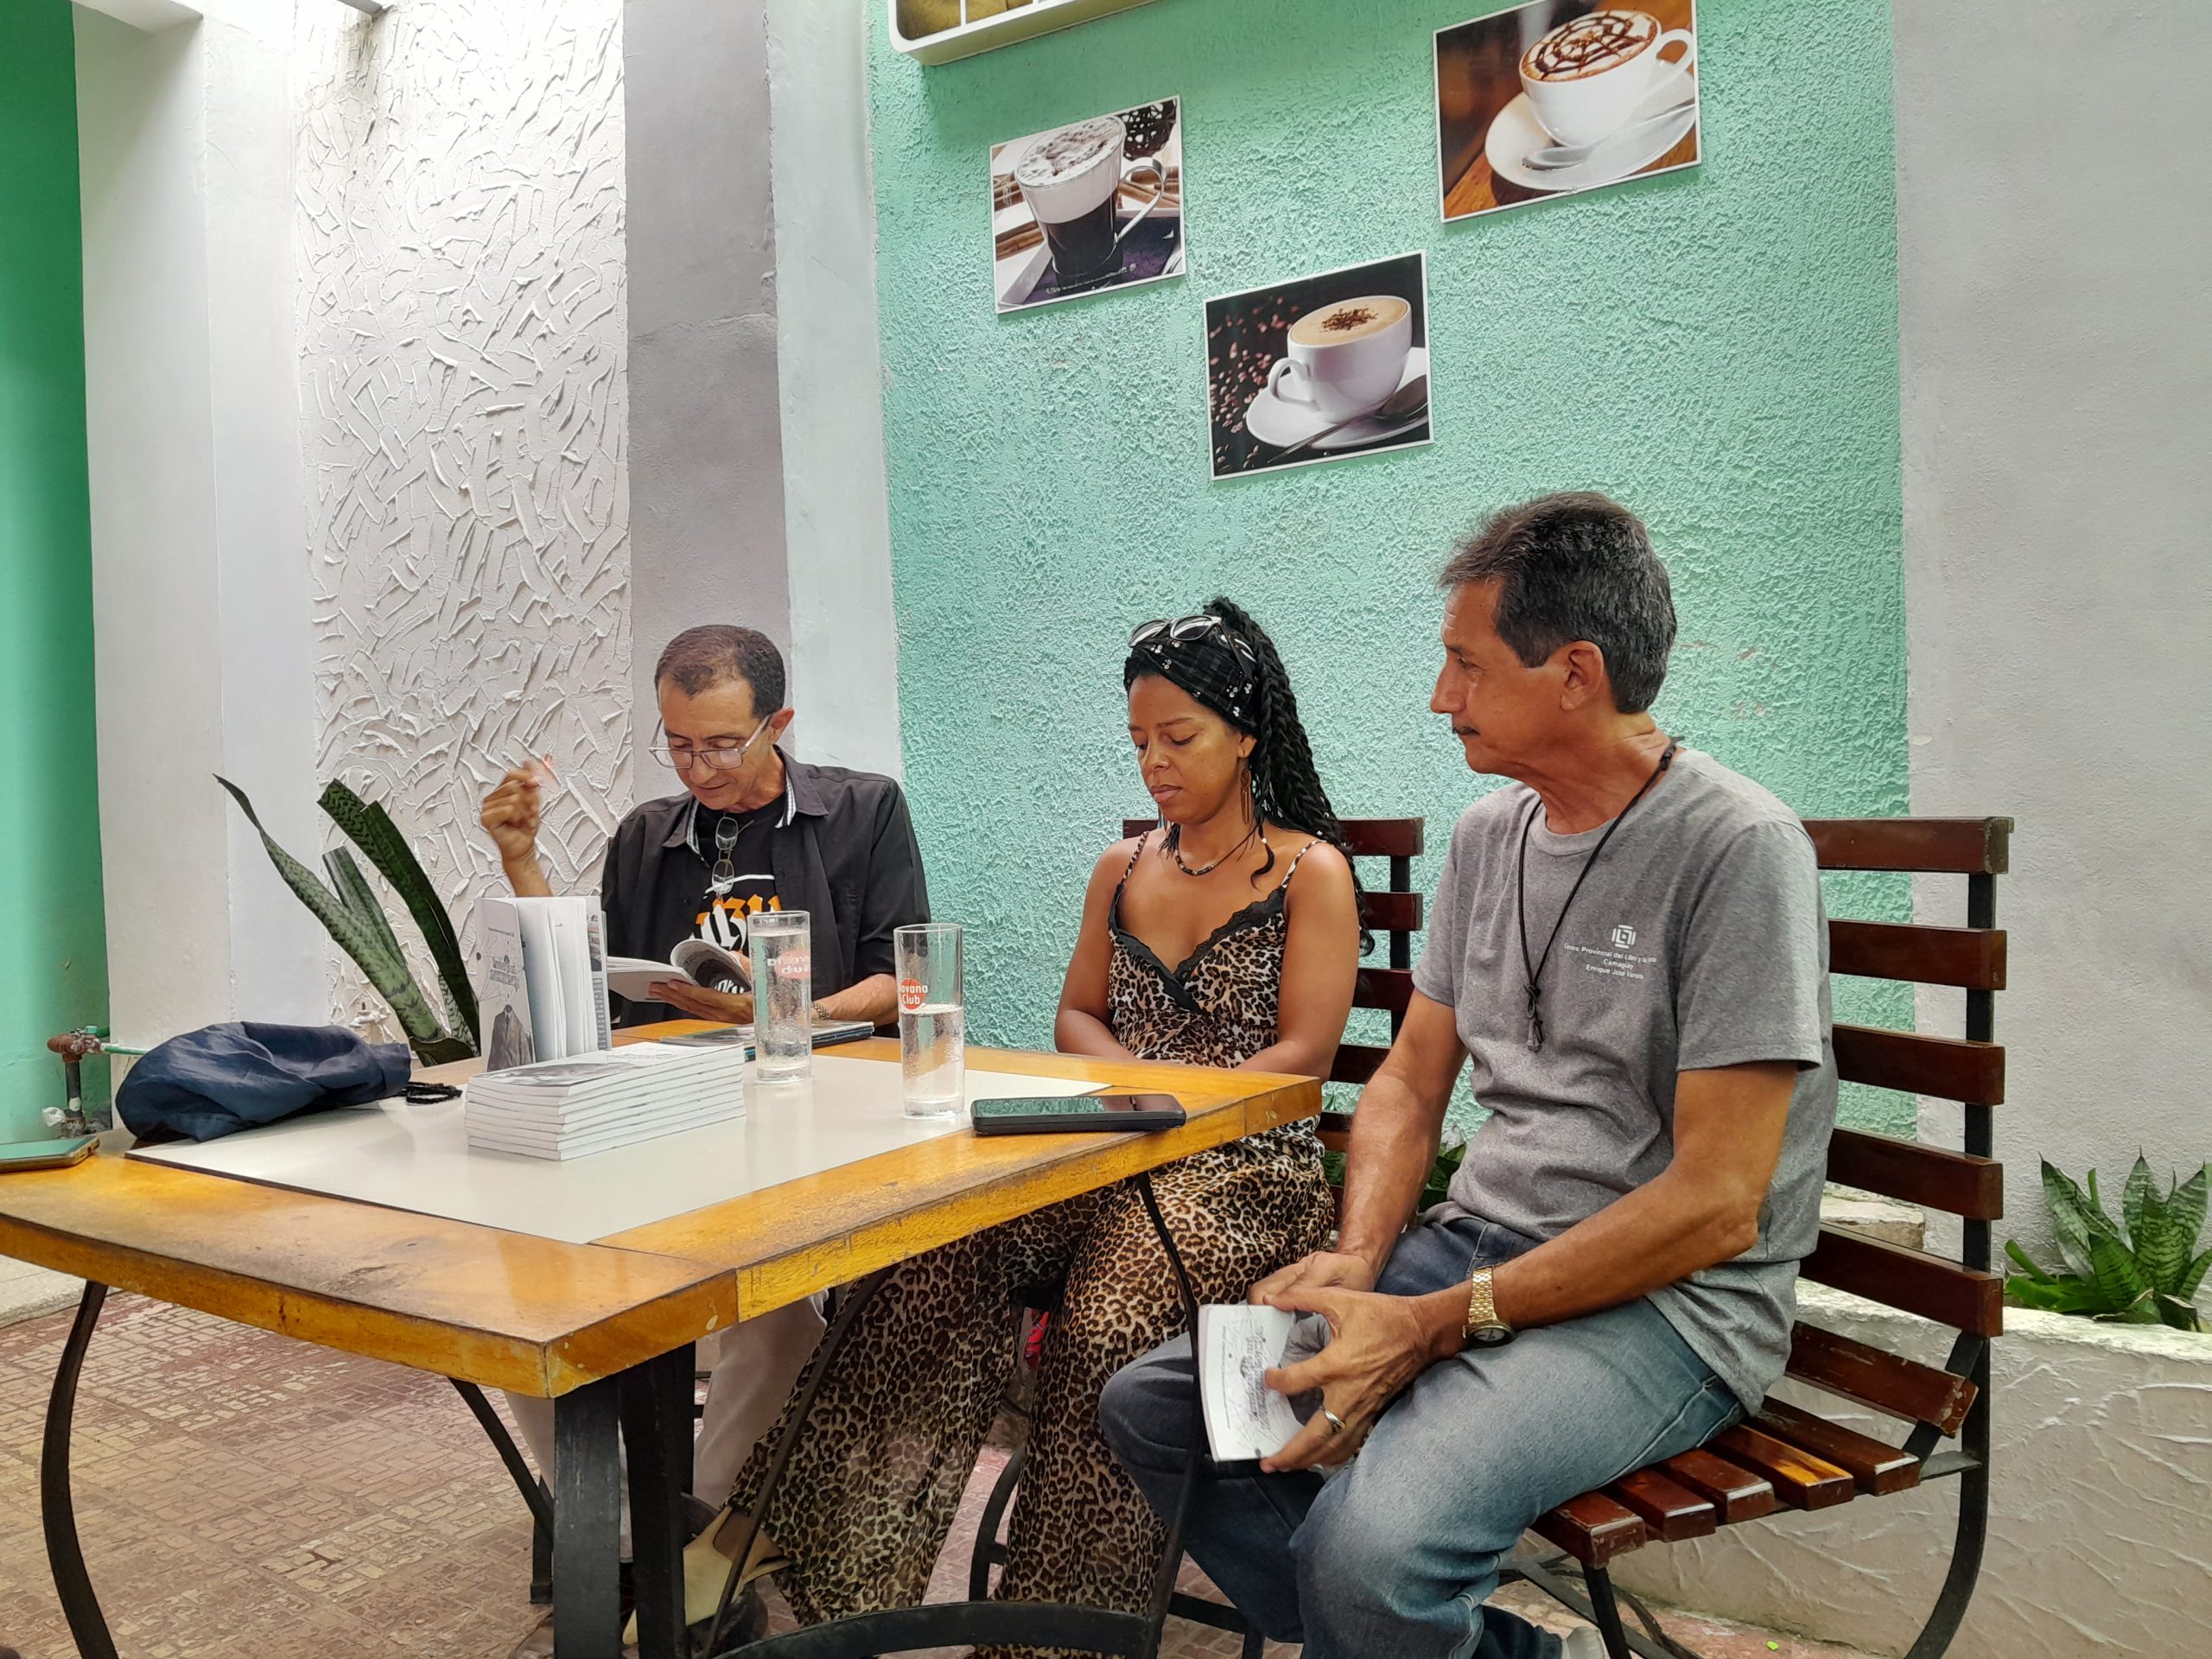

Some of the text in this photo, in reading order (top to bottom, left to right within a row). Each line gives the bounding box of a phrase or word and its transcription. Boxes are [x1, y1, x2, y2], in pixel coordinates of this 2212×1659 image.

[1581, 946, 1612, 957] Provincial
[1586, 963, 1611, 975] Enrique
[899, 984, 929, 994] avana
[901, 994, 920, 1005] Club
